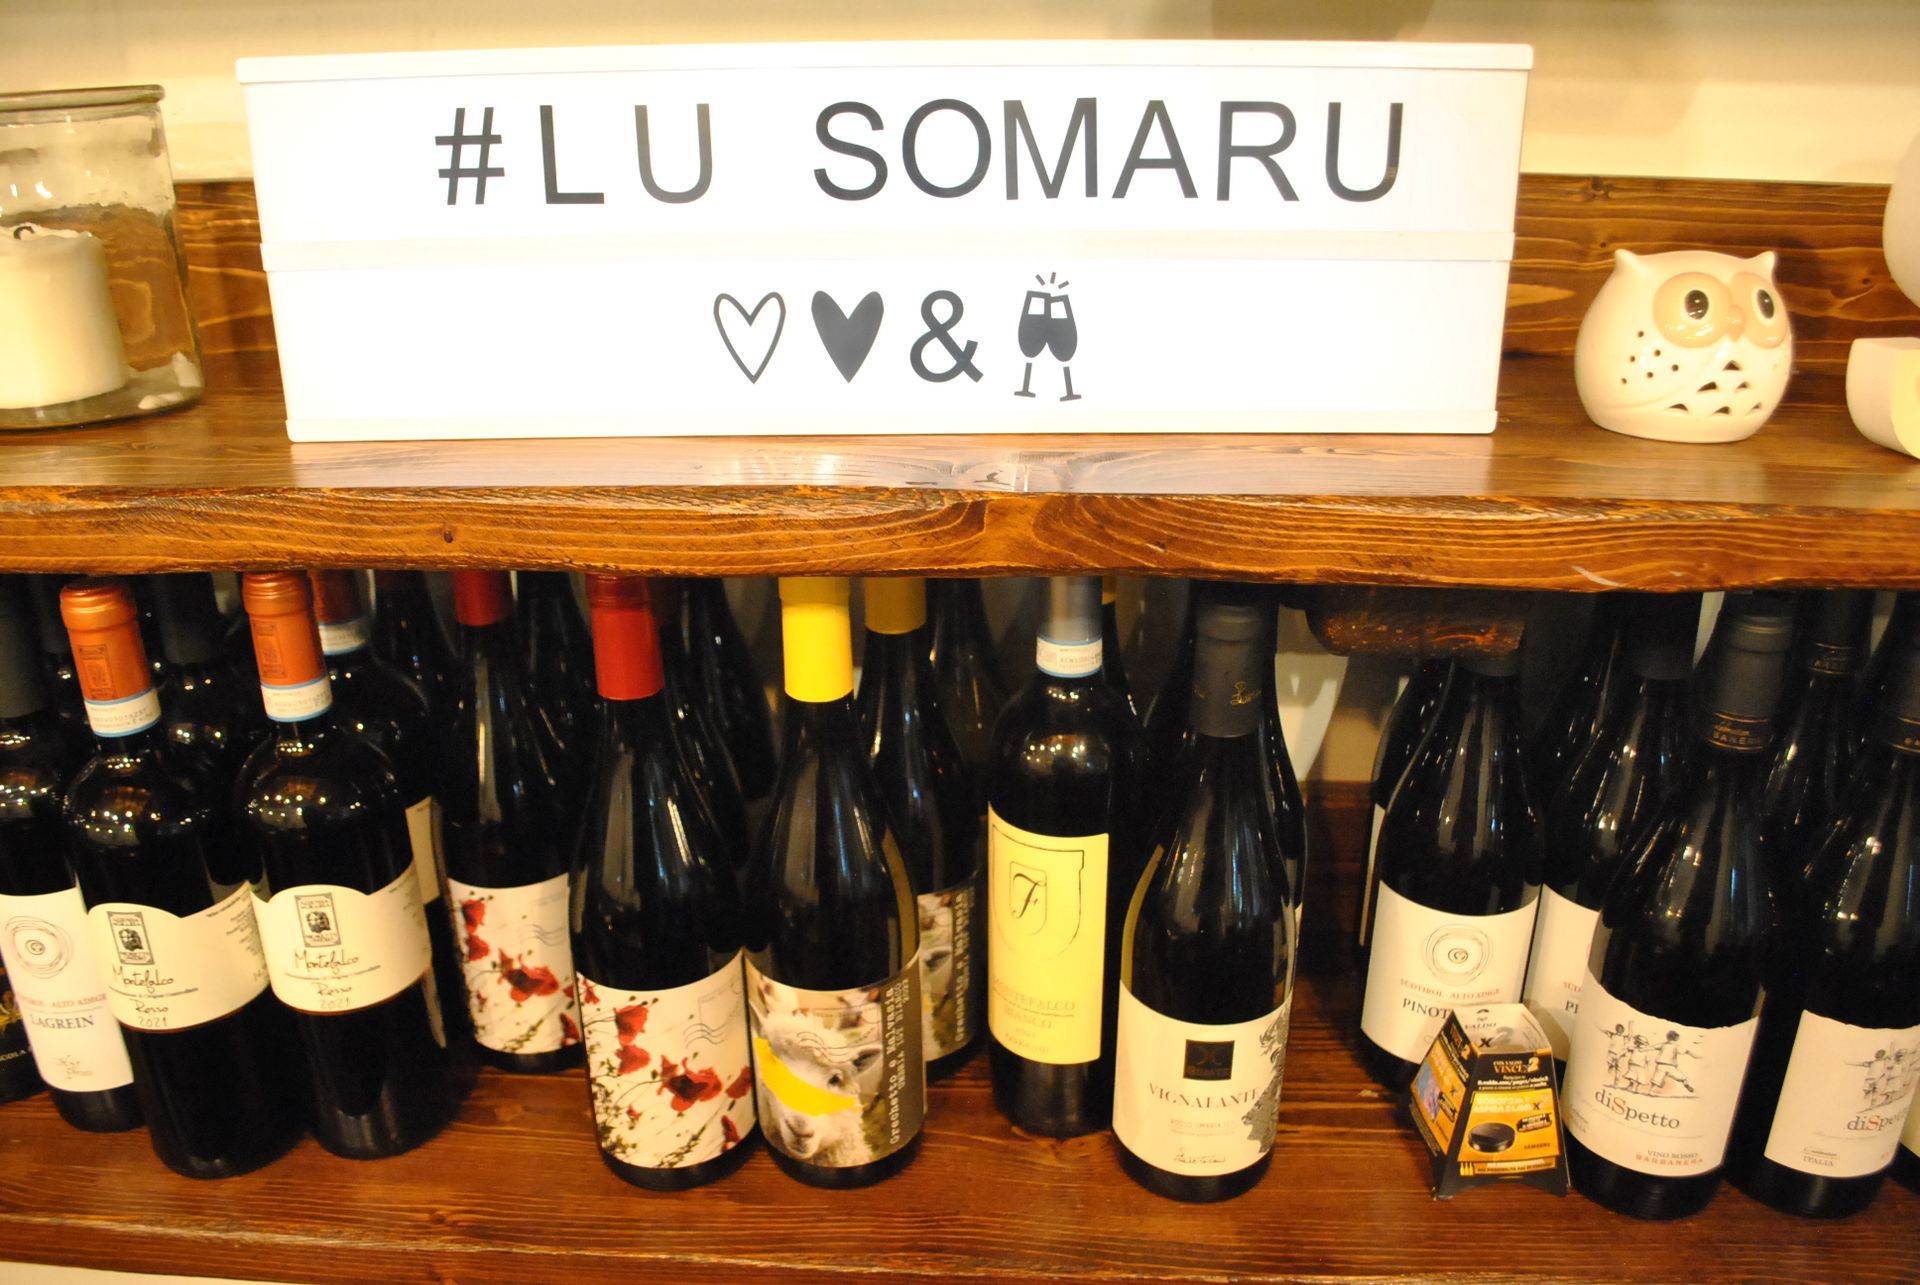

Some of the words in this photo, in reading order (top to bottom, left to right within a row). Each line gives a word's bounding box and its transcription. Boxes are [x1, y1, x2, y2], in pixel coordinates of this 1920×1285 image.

[812, 96, 1404, 203] SOMARU
[909, 288, 985, 385] &
[295, 949, 359, 974] Montefalco
[113, 965, 174, 993] Montefalco
[320, 998, 350, 1009] 2021
[1402, 997, 1450, 1019] PINOT
[30, 1014, 95, 1029] LAGREIN
[138, 1016, 168, 1027] 2021
[884, 986, 899, 1054] Malvasia
[887, 1075, 900, 1145] Grechetto
[1594, 1089, 1680, 1129] diSpetto
[1647, 1149, 1670, 1158] VINO
[1671, 1151, 1698, 1159] ROSSO
[1803, 1155, 1834, 1167] ITALIA
